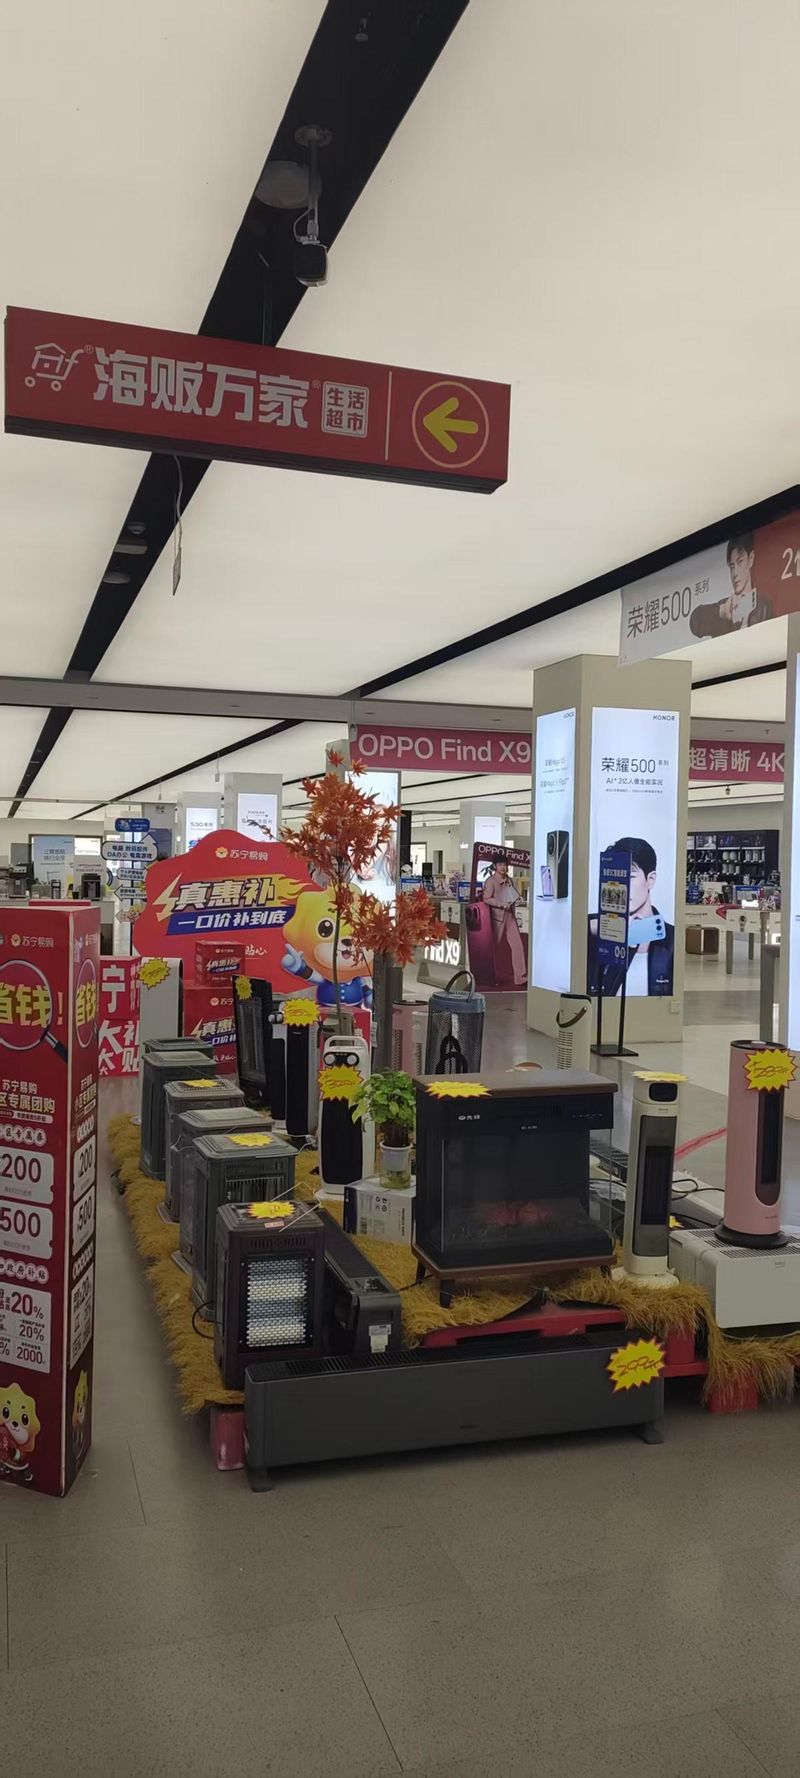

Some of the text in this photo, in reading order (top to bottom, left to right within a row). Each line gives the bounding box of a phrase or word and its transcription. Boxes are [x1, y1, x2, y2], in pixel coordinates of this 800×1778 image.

[93, 346, 310, 429] 海贩万家
[326, 386, 366, 411] 生活
[325, 408, 365, 432] 超市
[627, 586, 692, 639] 荣耀500
[652, 714, 676, 722] HONOR
[358, 733, 531, 763] OPPO Find X9
[689, 747, 785, 773] 超清晰 4K
[601, 757, 656, 774] 荣耀500
[229, 849, 269, 862] 苏宁易购
[506, 850, 524, 861] Find
[174, 876, 276, 912] 真惠补
[178, 910, 289, 930] 一口价补到底
[22, 936, 54, 949] 苏宁易购
[2, 1078, 39, 1095] 苏宁易购
[0, 1152, 42, 1184] 200
[0, 1206, 41, 1238] 500
[11, 1291, 44, 1320] 20%
[19, 1324, 45, 1342] 20%
[17, 1346, 43, 1364] 2000
